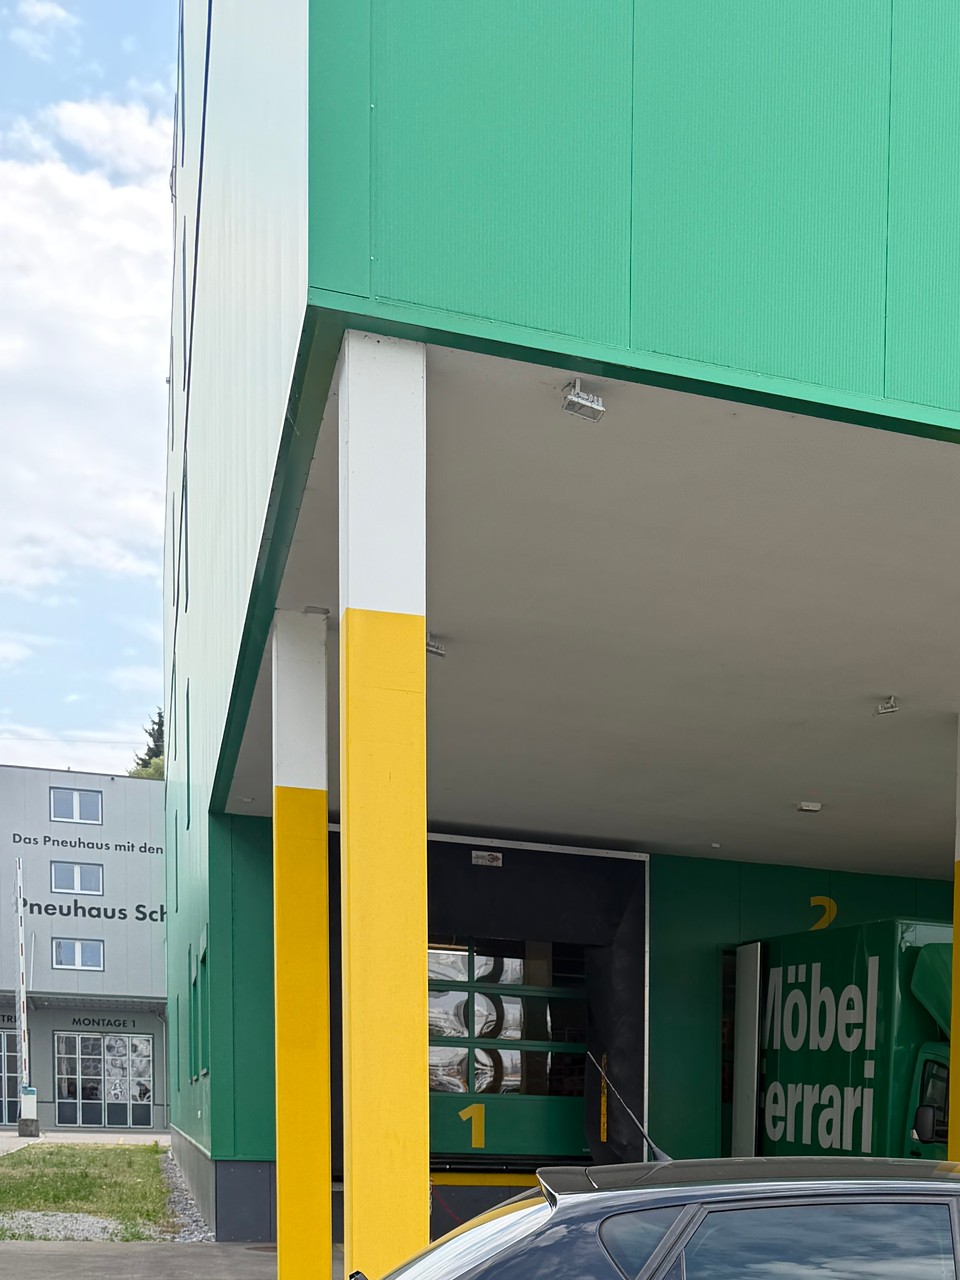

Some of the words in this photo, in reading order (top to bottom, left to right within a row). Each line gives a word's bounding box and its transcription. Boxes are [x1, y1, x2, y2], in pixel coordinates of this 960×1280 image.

[12, 833, 39, 846] Das
[43, 835, 111, 851] Pneuhaus
[114, 841, 136, 853] mit
[138, 842, 164, 854] den
[72, 1017, 128, 1028] MONTAGE
[132, 1019, 136, 1028] 1
[761, 1059, 875, 1154] errari
[458, 1103, 486, 1149] 1
